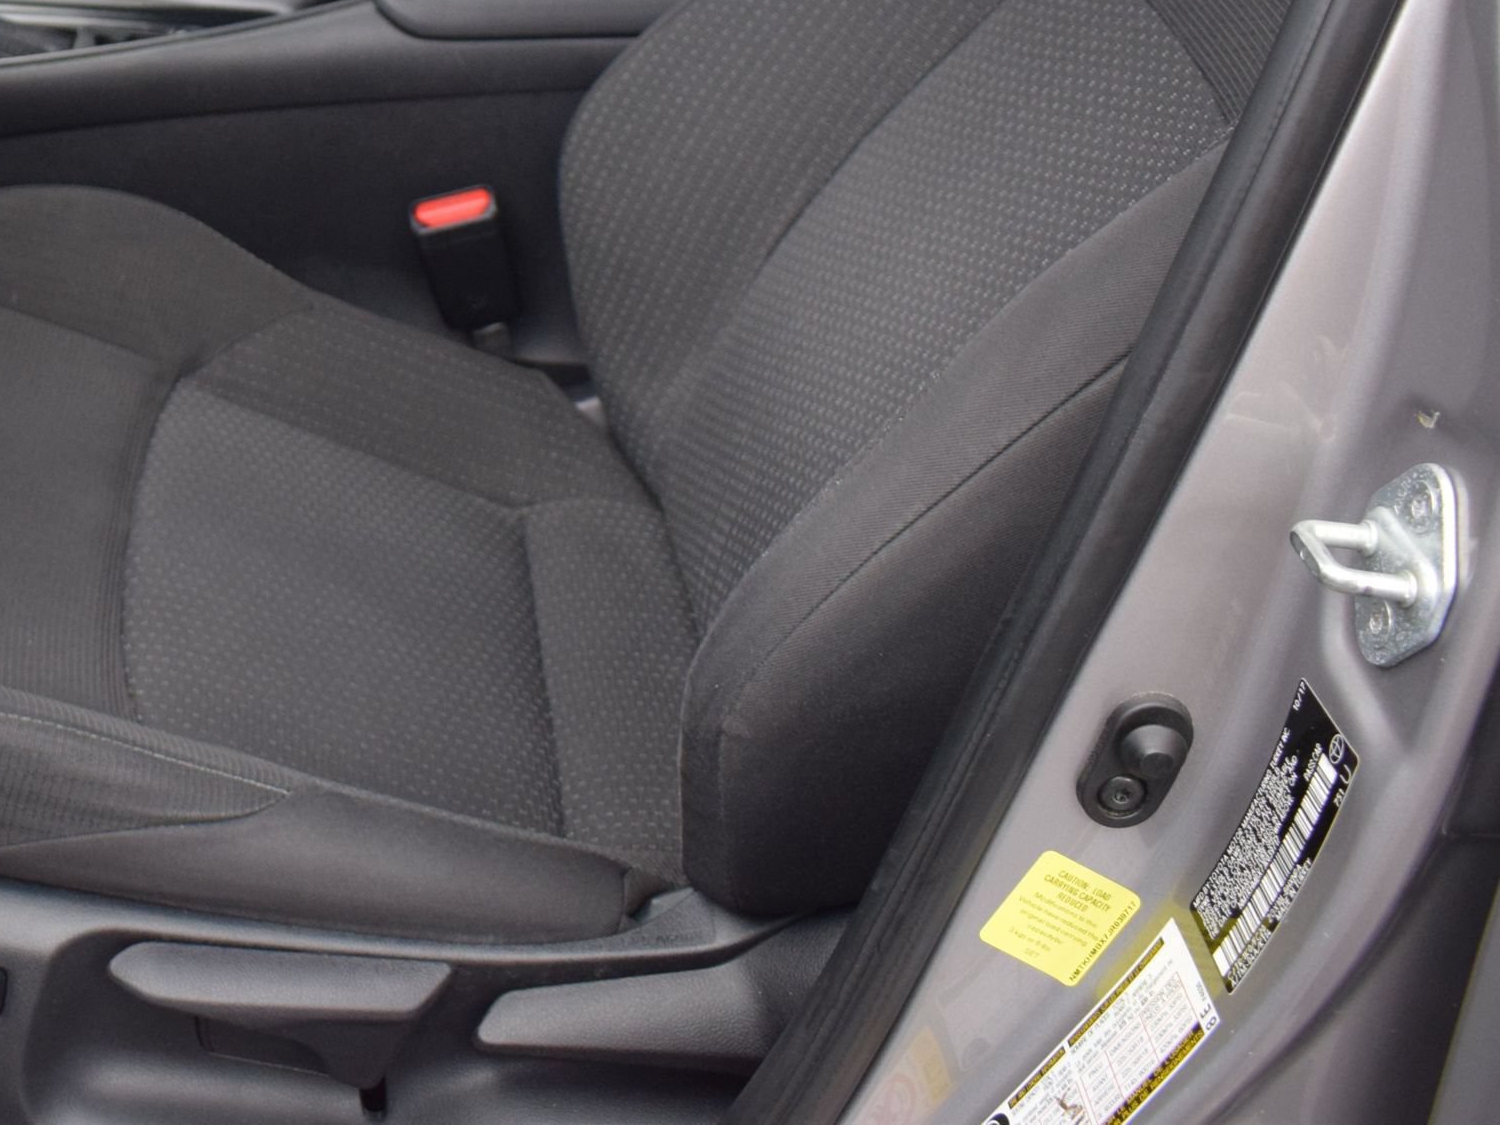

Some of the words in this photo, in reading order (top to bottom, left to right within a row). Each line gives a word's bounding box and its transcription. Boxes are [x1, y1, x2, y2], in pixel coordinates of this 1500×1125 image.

[1042, 873, 1080, 896] CARRYING
[1076, 891, 1111, 912] CAPACITY
[1054, 891, 1090, 912] REDUCED
